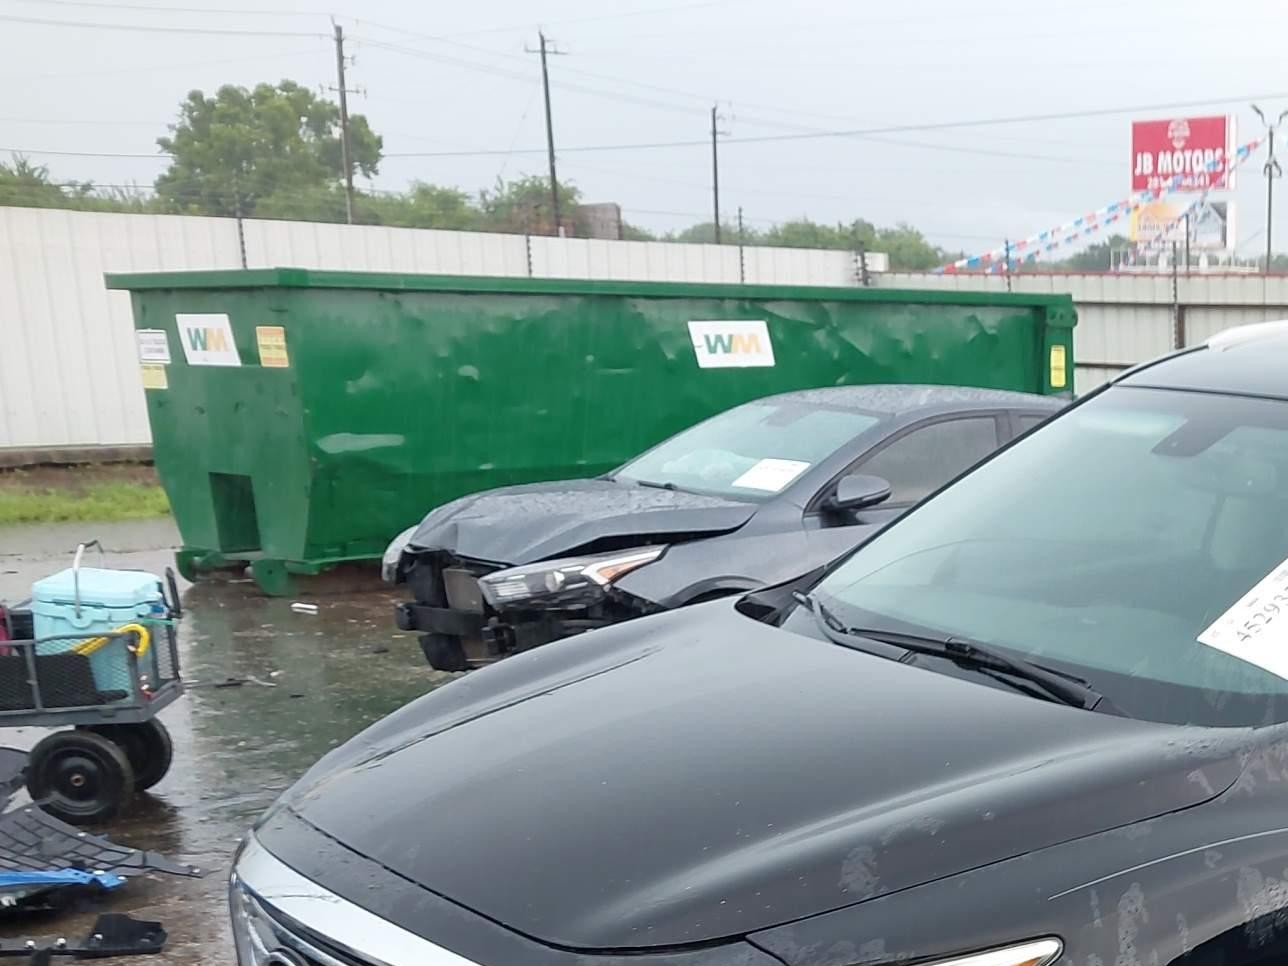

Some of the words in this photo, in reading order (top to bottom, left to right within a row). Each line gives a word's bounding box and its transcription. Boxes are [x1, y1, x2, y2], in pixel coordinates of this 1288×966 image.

[1134, 151, 1154, 176] JB
[187, 327, 230, 352] WM
[703, 333, 763, 354] WM
